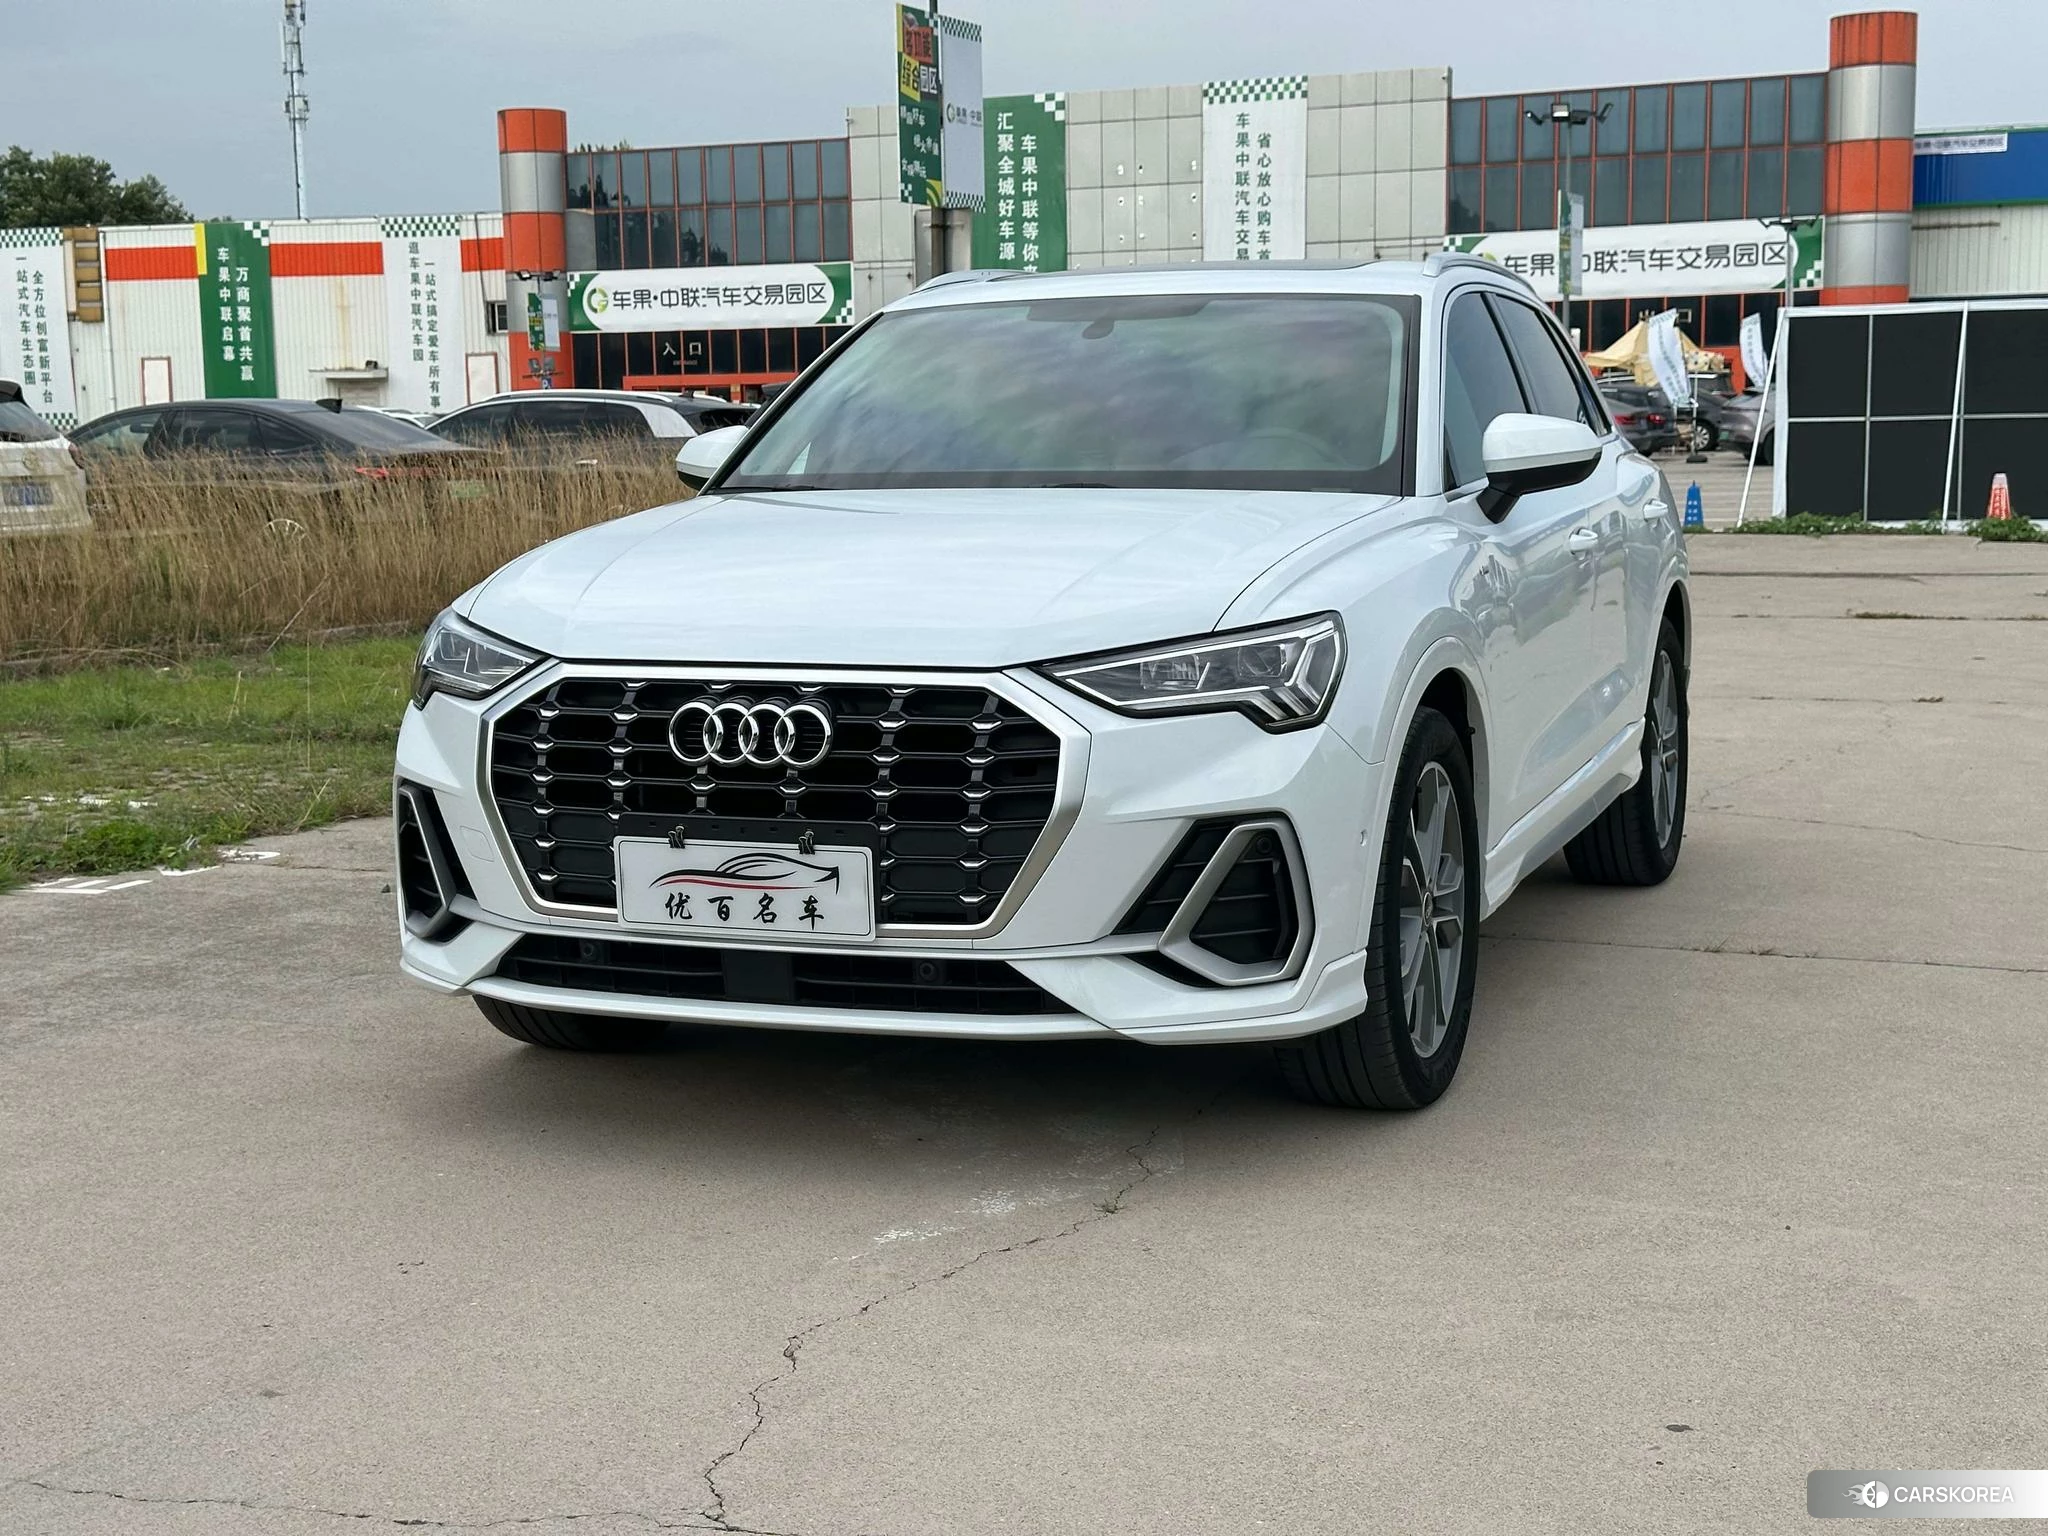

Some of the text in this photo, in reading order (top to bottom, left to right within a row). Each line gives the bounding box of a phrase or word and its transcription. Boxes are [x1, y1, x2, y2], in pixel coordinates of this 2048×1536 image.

[997, 112, 1015, 260] 汇聚全城好车源
[1235, 113, 1250, 260] 车果中联汽车交易
[1257, 132, 1271, 260] 省心放心购车首
[612, 282, 827, 311] 车果·中联汽车交易园区
[1504, 241, 1787, 278] 车果联汽车交易园区
[15, 256, 36, 385] 一站式汽车生态圈
[33, 270, 53, 403] 全方位创富新平台
[236, 267, 254, 381] 万商聚首共赢
[662, 342, 702, 356] 入口
[665, 892, 825, 930] 优百名车
